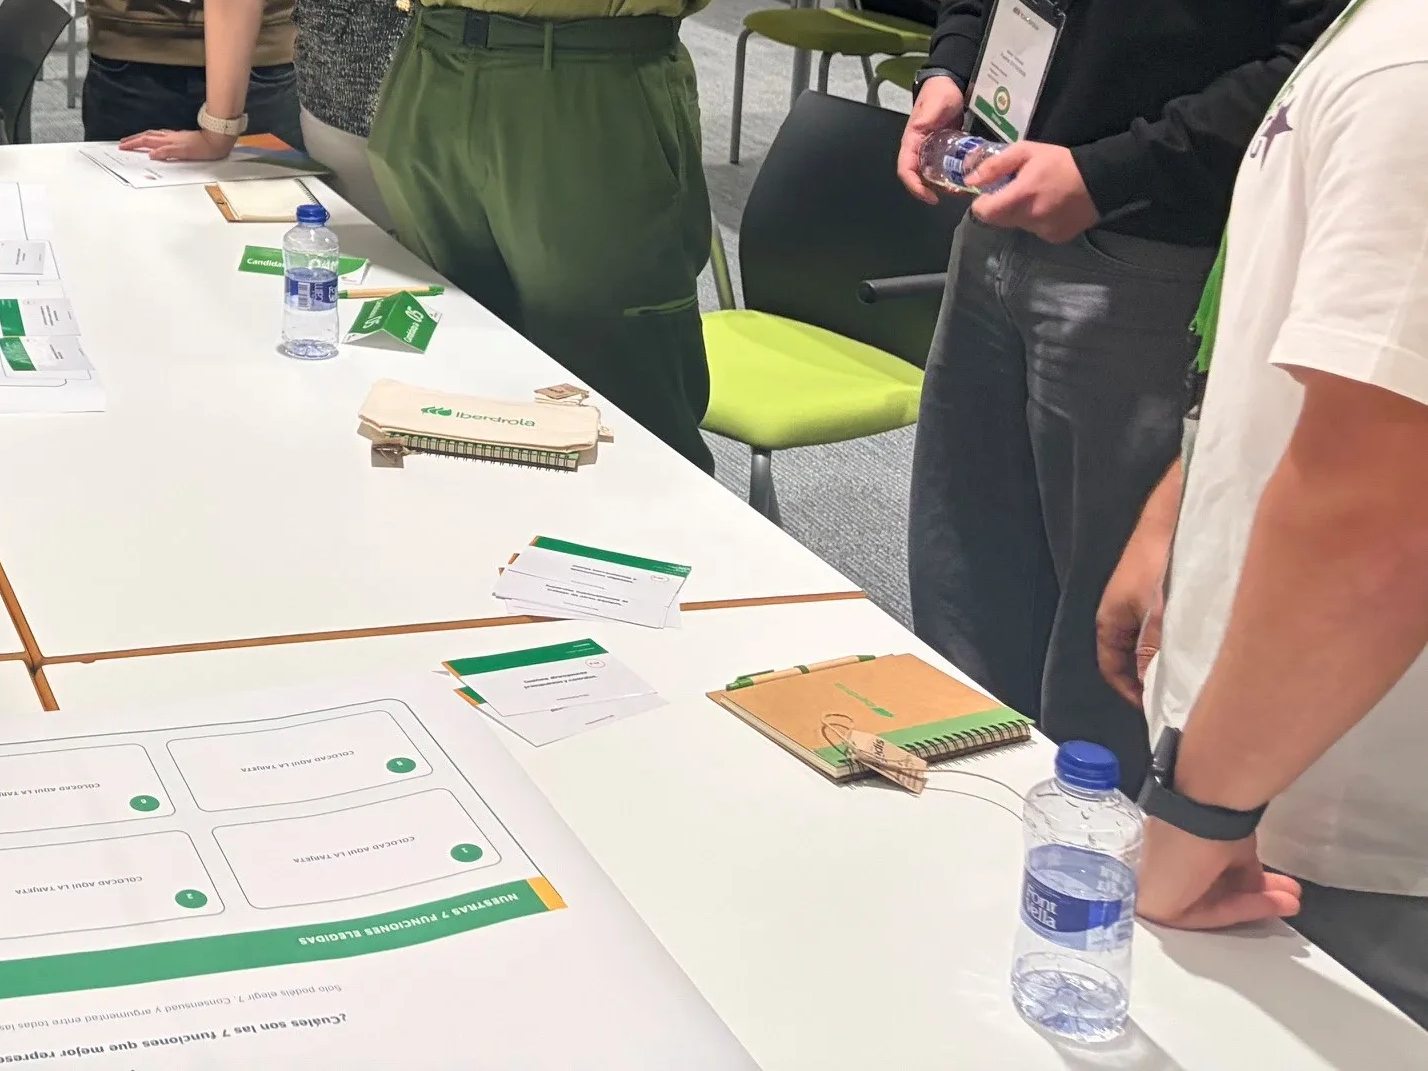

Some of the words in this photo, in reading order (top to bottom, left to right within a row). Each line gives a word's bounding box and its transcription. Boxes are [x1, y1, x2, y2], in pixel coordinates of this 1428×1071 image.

[405, 304, 425, 323] 05
[455, 410, 536, 428] Iberdrola
[314, 750, 354, 762] COLOCAD
[291, 758, 311, 766] AQUÍ
[241, 764, 276, 773] TARJETA
[59, 783, 100, 791] COLOCAD
[372, 836, 415, 850] COLOCAD
[347, 846, 369, 856] AQUÍ
[293, 854, 331, 864] TARJETA
[72, 881, 95, 889] AQUÍ
[98, 876, 142, 886] COLOCAD
[15, 886, 55, 895] TARJETA
[451, 892, 518, 916] NUESTRAS
[440, 910, 449, 919] 7
[363, 913, 438, 936] FUNCIONES
[298, 929, 361, 946] ELEGIDAS
[280, 986, 315, 999] podéis
[318, 984, 342, 993] Solo
[233, 995, 244, 1003] 7.
[248, 991, 277, 1002] elegir
[155, 1006, 161, 1014] y
[165, 996, 230, 1013] Consensuad
[52, 1017, 81, 1026] entre
[85, 1009, 151, 1025] argumentad
[291, 1013, 348, 1030] ¿Cuáles
[18, 1019, 49, 1030] todas
[233, 1025, 257, 1035] las
[260, 1021, 286, 1032] son
[222, 1028, 230, 1038] 7
[142, 1031, 217, 1049] funciones
[60, 1045, 104, 1059] mejor
[109, 1041, 138, 1052] que
